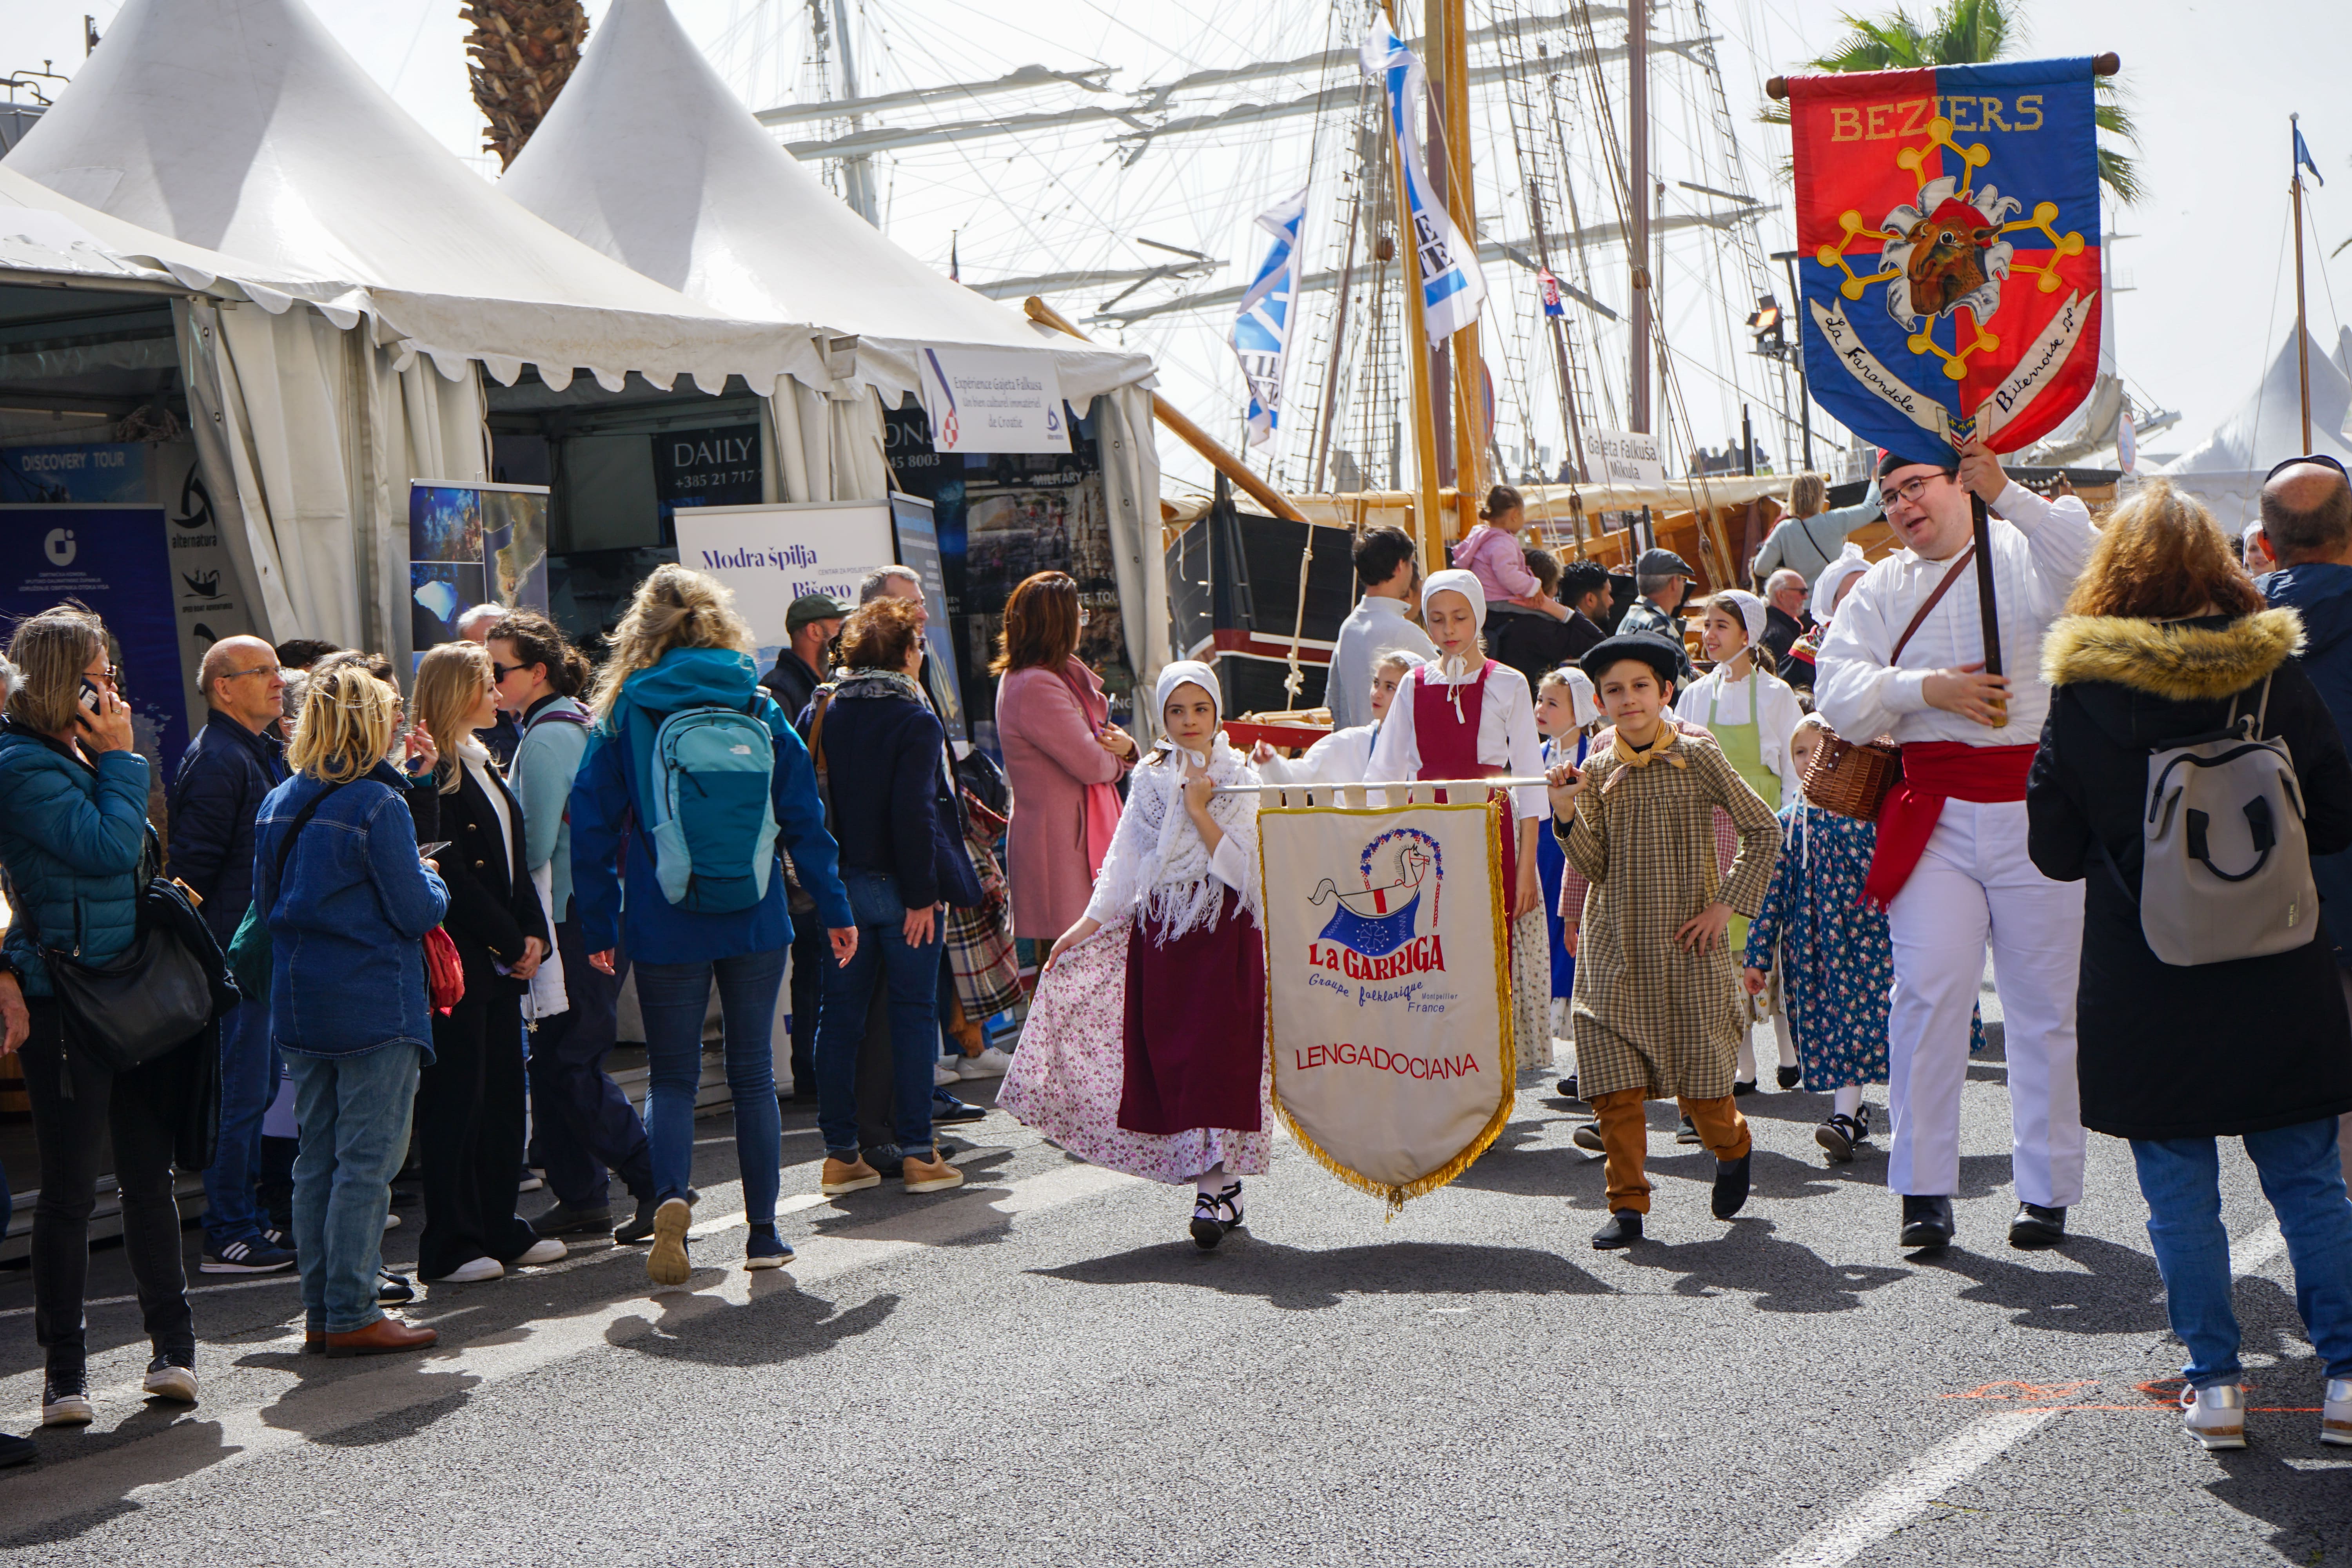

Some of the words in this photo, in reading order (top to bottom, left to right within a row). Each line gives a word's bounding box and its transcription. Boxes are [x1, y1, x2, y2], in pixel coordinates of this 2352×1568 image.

[1831, 95, 2043, 142] BEZIERS
[1826, 318, 1845, 345] La
[1844, 347, 1915, 412] Farandole
[1996, 339, 2064, 413] Biterroise
[954, 377, 992, 394] Expérience
[993, 378, 1016, 395] Gajeta
[989, 414, 997, 427] de
[998, 416, 1023, 427] Croatie
[674, 437, 753, 467] DAILY
[1620, 439, 1657, 461] Falkuša
[22, 452, 86, 471] DISCOVERY
[93, 451, 125, 468] TOUR
[908, 454, 940, 467] 8003
[1610, 460, 1641, 480] Mikula
[675, 474, 707, 488] +385
[711, 473, 725, 485] 21
[731, 470, 754, 483] 717
[1033, 471, 1082, 486] MILITARY
[172, 533, 217, 548] alternatura
[702, 547, 764, 570] Modra
[769, 544, 818, 570] špilja
[1308, 943, 1340, 971] La
[1343, 935, 1446, 980] GARRIGA
[1309, 973, 1349, 997] Groupe
[1359, 982, 1423, 1007] folklorique
[1408, 1002, 1445, 1013] France
[1296, 1043, 1480, 1080] LENGADOCIANA
